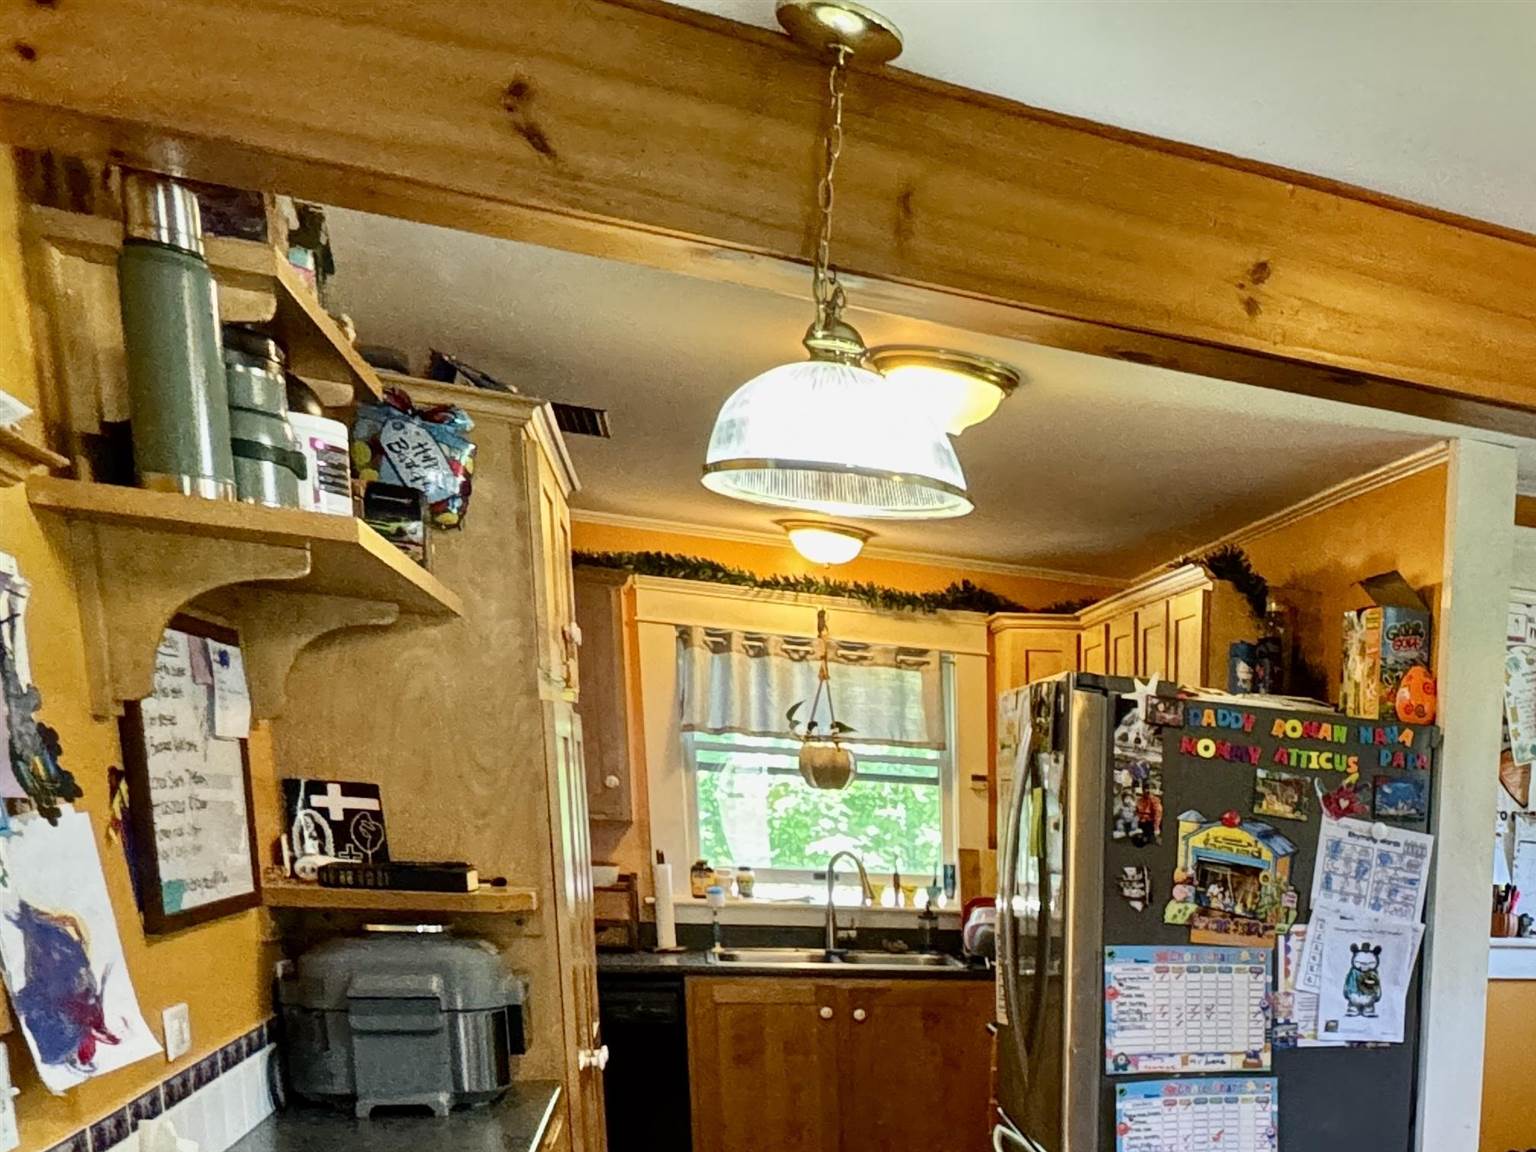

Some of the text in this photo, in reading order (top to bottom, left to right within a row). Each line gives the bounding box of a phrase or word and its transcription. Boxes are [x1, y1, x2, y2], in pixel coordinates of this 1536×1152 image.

[1188, 708, 1414, 747] DADDY ROMAN NANA
[1180, 736, 1428, 773] MOMMY ATTICUS PAPA
